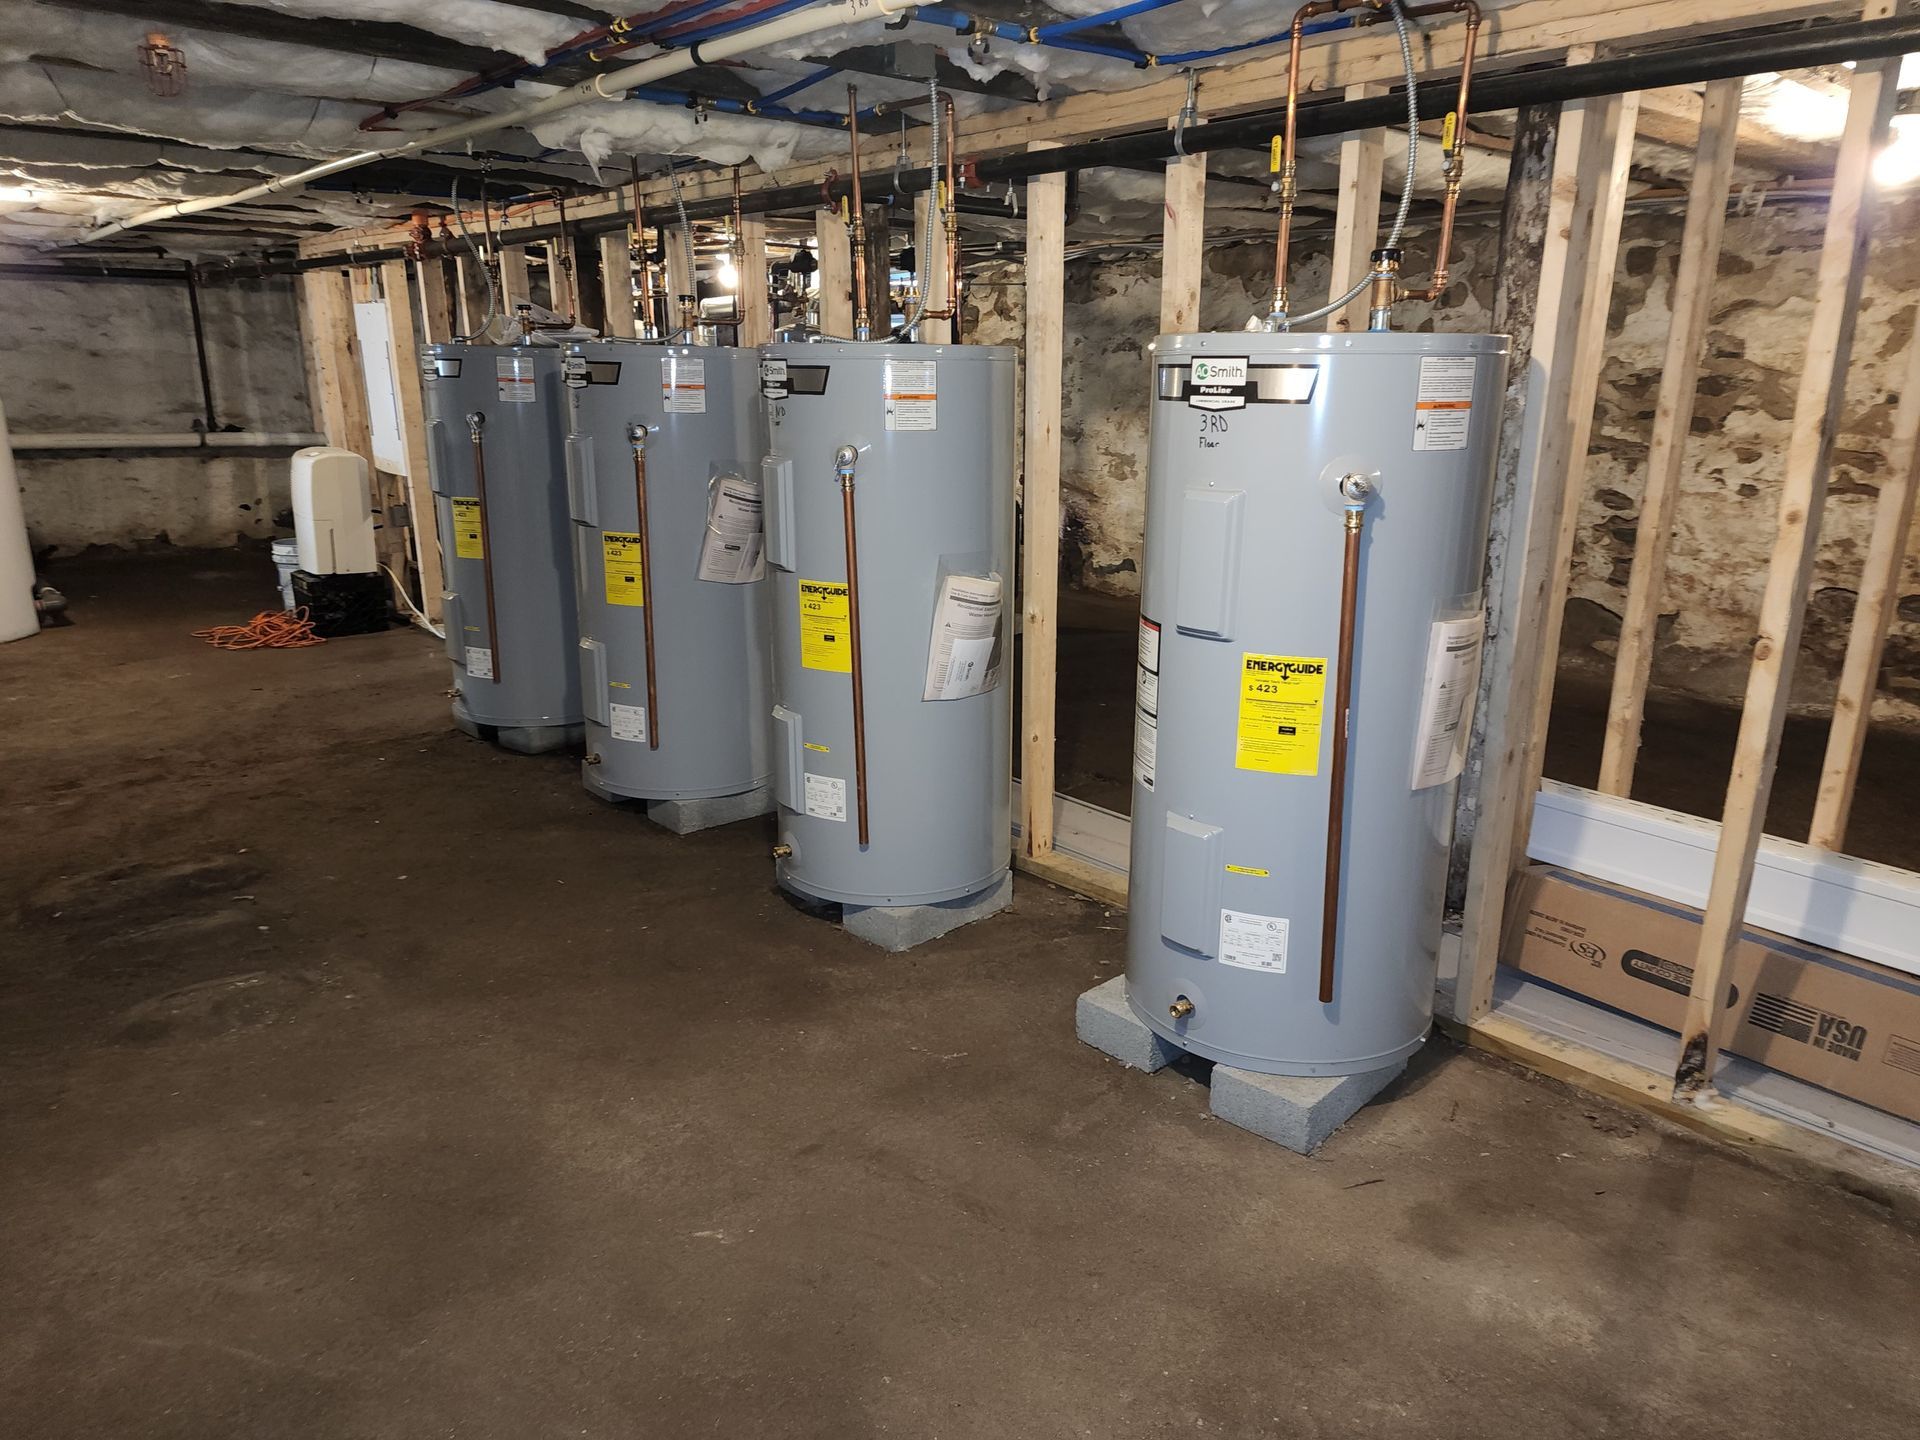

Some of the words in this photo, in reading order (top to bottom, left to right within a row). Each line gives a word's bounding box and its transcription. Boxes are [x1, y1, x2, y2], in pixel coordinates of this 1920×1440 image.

[1200, 386, 1233, 395] ProLine
[808, 602, 821, 611] 423
[1246, 659, 1324, 675] ENERGYGUIDE
[1256, 683, 1278, 694] 423
[1818, 1013, 1867, 1050] USA
[1813, 1036, 1826, 1049] IN
[1828, 1041, 1861, 1061] MADE
